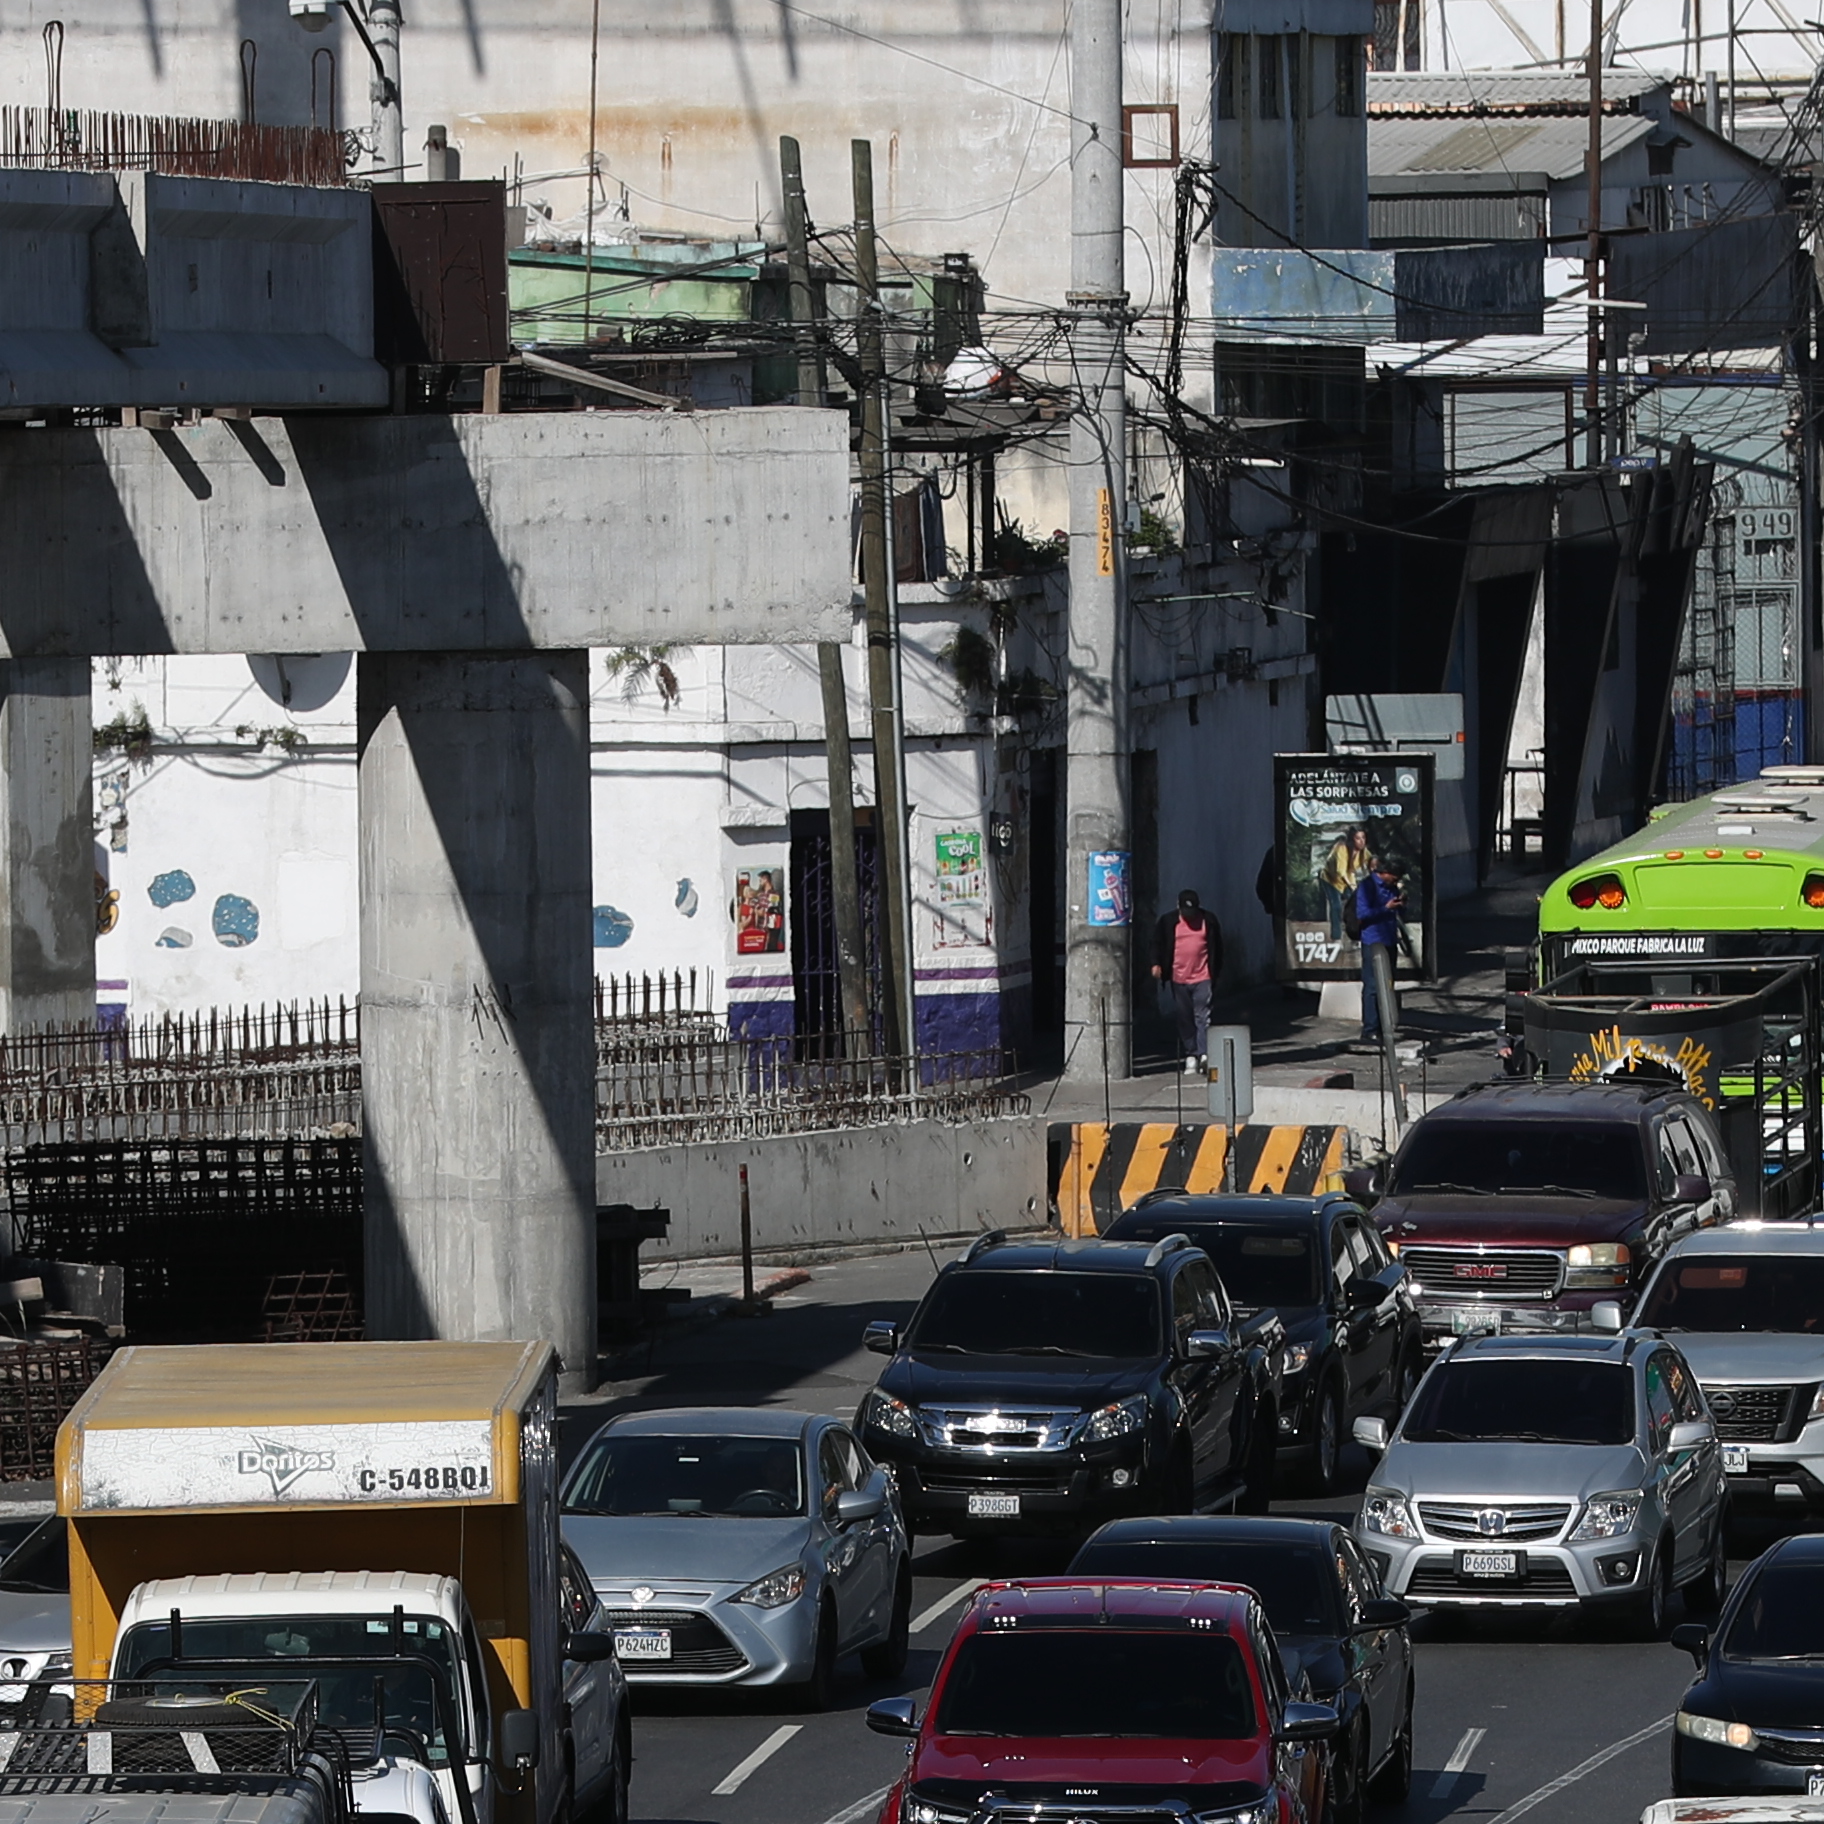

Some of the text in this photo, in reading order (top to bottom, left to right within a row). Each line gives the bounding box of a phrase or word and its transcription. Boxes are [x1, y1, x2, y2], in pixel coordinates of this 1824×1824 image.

[1101, 488, 1110, 572] 183474
[1289, 785, 1389, 798] LAS SORPRESAS
[1320, 800, 1348, 815] Salud
[1294, 943, 1341, 963] 1747
[1571, 937, 1706, 954] MIXCO PARQUE FABRICA LA LUZ
[1453, 1265, 1507, 1278] GMC
[237, 1449, 337, 1474] Doritos
[1465, 1556, 1514, 1571] P669GSL
[617, 1638, 668, 1651] P624HZC
